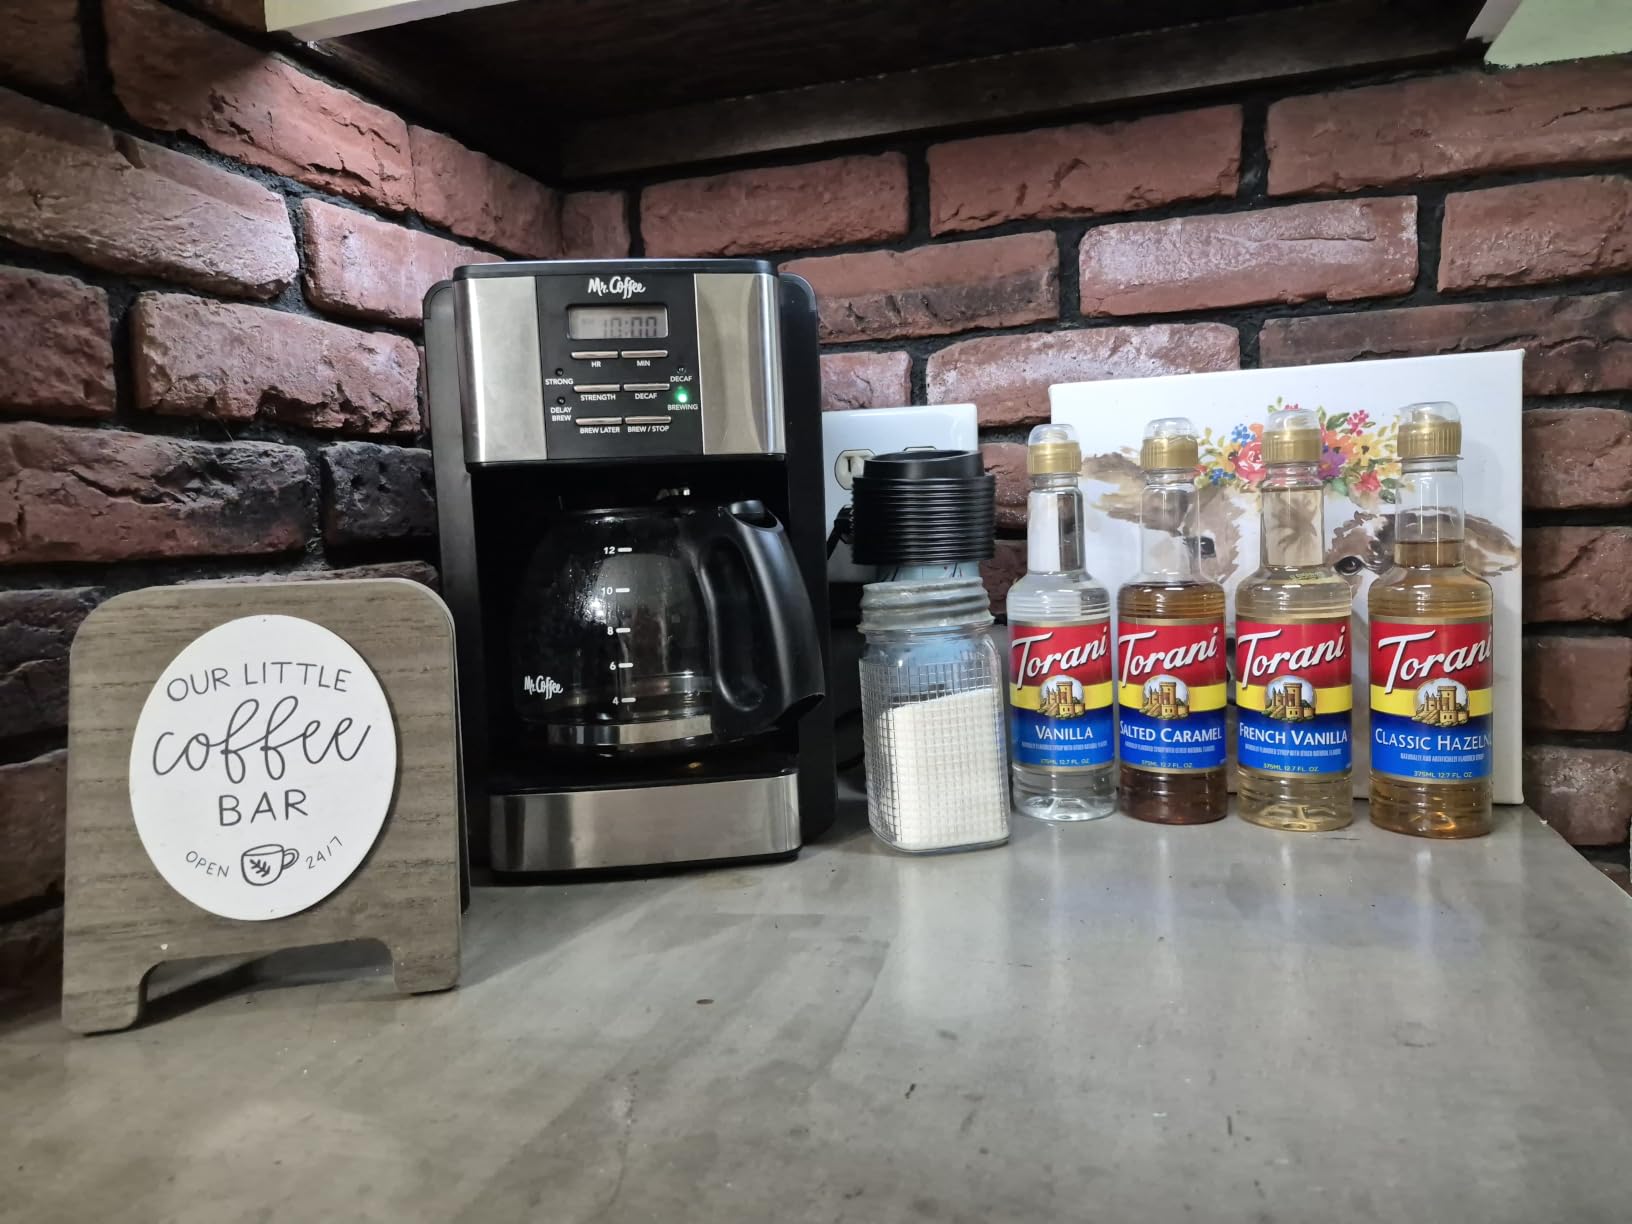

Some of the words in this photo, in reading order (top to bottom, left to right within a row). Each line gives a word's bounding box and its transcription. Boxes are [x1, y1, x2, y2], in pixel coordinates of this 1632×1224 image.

[588, 277, 609, 297] Mr.
[609, 275, 646, 299] Coffee
[603, 316, 657, 338] 10:00
[544, 378, 574, 386] STRONG
[669, 375, 693, 383] DECAF
[580, 393, 616, 402] STRENGTH
[634, 392, 658, 400] DECAF
[550, 406, 572, 414] DELAY
[667, 403, 699, 411] BREWING
[551, 414, 572, 422] BREW
[579, 426, 600, 434] BREW
[600, 426, 620, 434] LATER
[627, 425, 647, 433] BREW
[603, 546, 616, 554] 12
[601, 586, 613, 595] 10
[607, 626, 614, 636] 8
[1011, 626, 1108, 691] Torani
[1118, 626, 1219, 689] Torani
[1237, 625, 1347, 689] Torani
[609, 661, 617, 671] 6
[166, 667, 231, 702] OUR
[244, 661, 353, 693] LITTLE
[536, 674, 564, 700] Coffee
[612, 696, 620, 706] 4
[1035, 724, 1094, 741] VANILLA
[1120, 720, 1156, 742] SALTED
[1160, 727, 1222, 743] CARAMEL
[1239, 722, 1287, 745] FRENCH
[1290, 729, 1348, 746] VANILLA
[152, 695, 372, 785] coffee
[1375, 727, 1432, 751] CLASSIC
[217, 789, 309, 827] BAR
[185, 850, 230, 878] OPEN
[304, 835, 344, 870] 24/7
